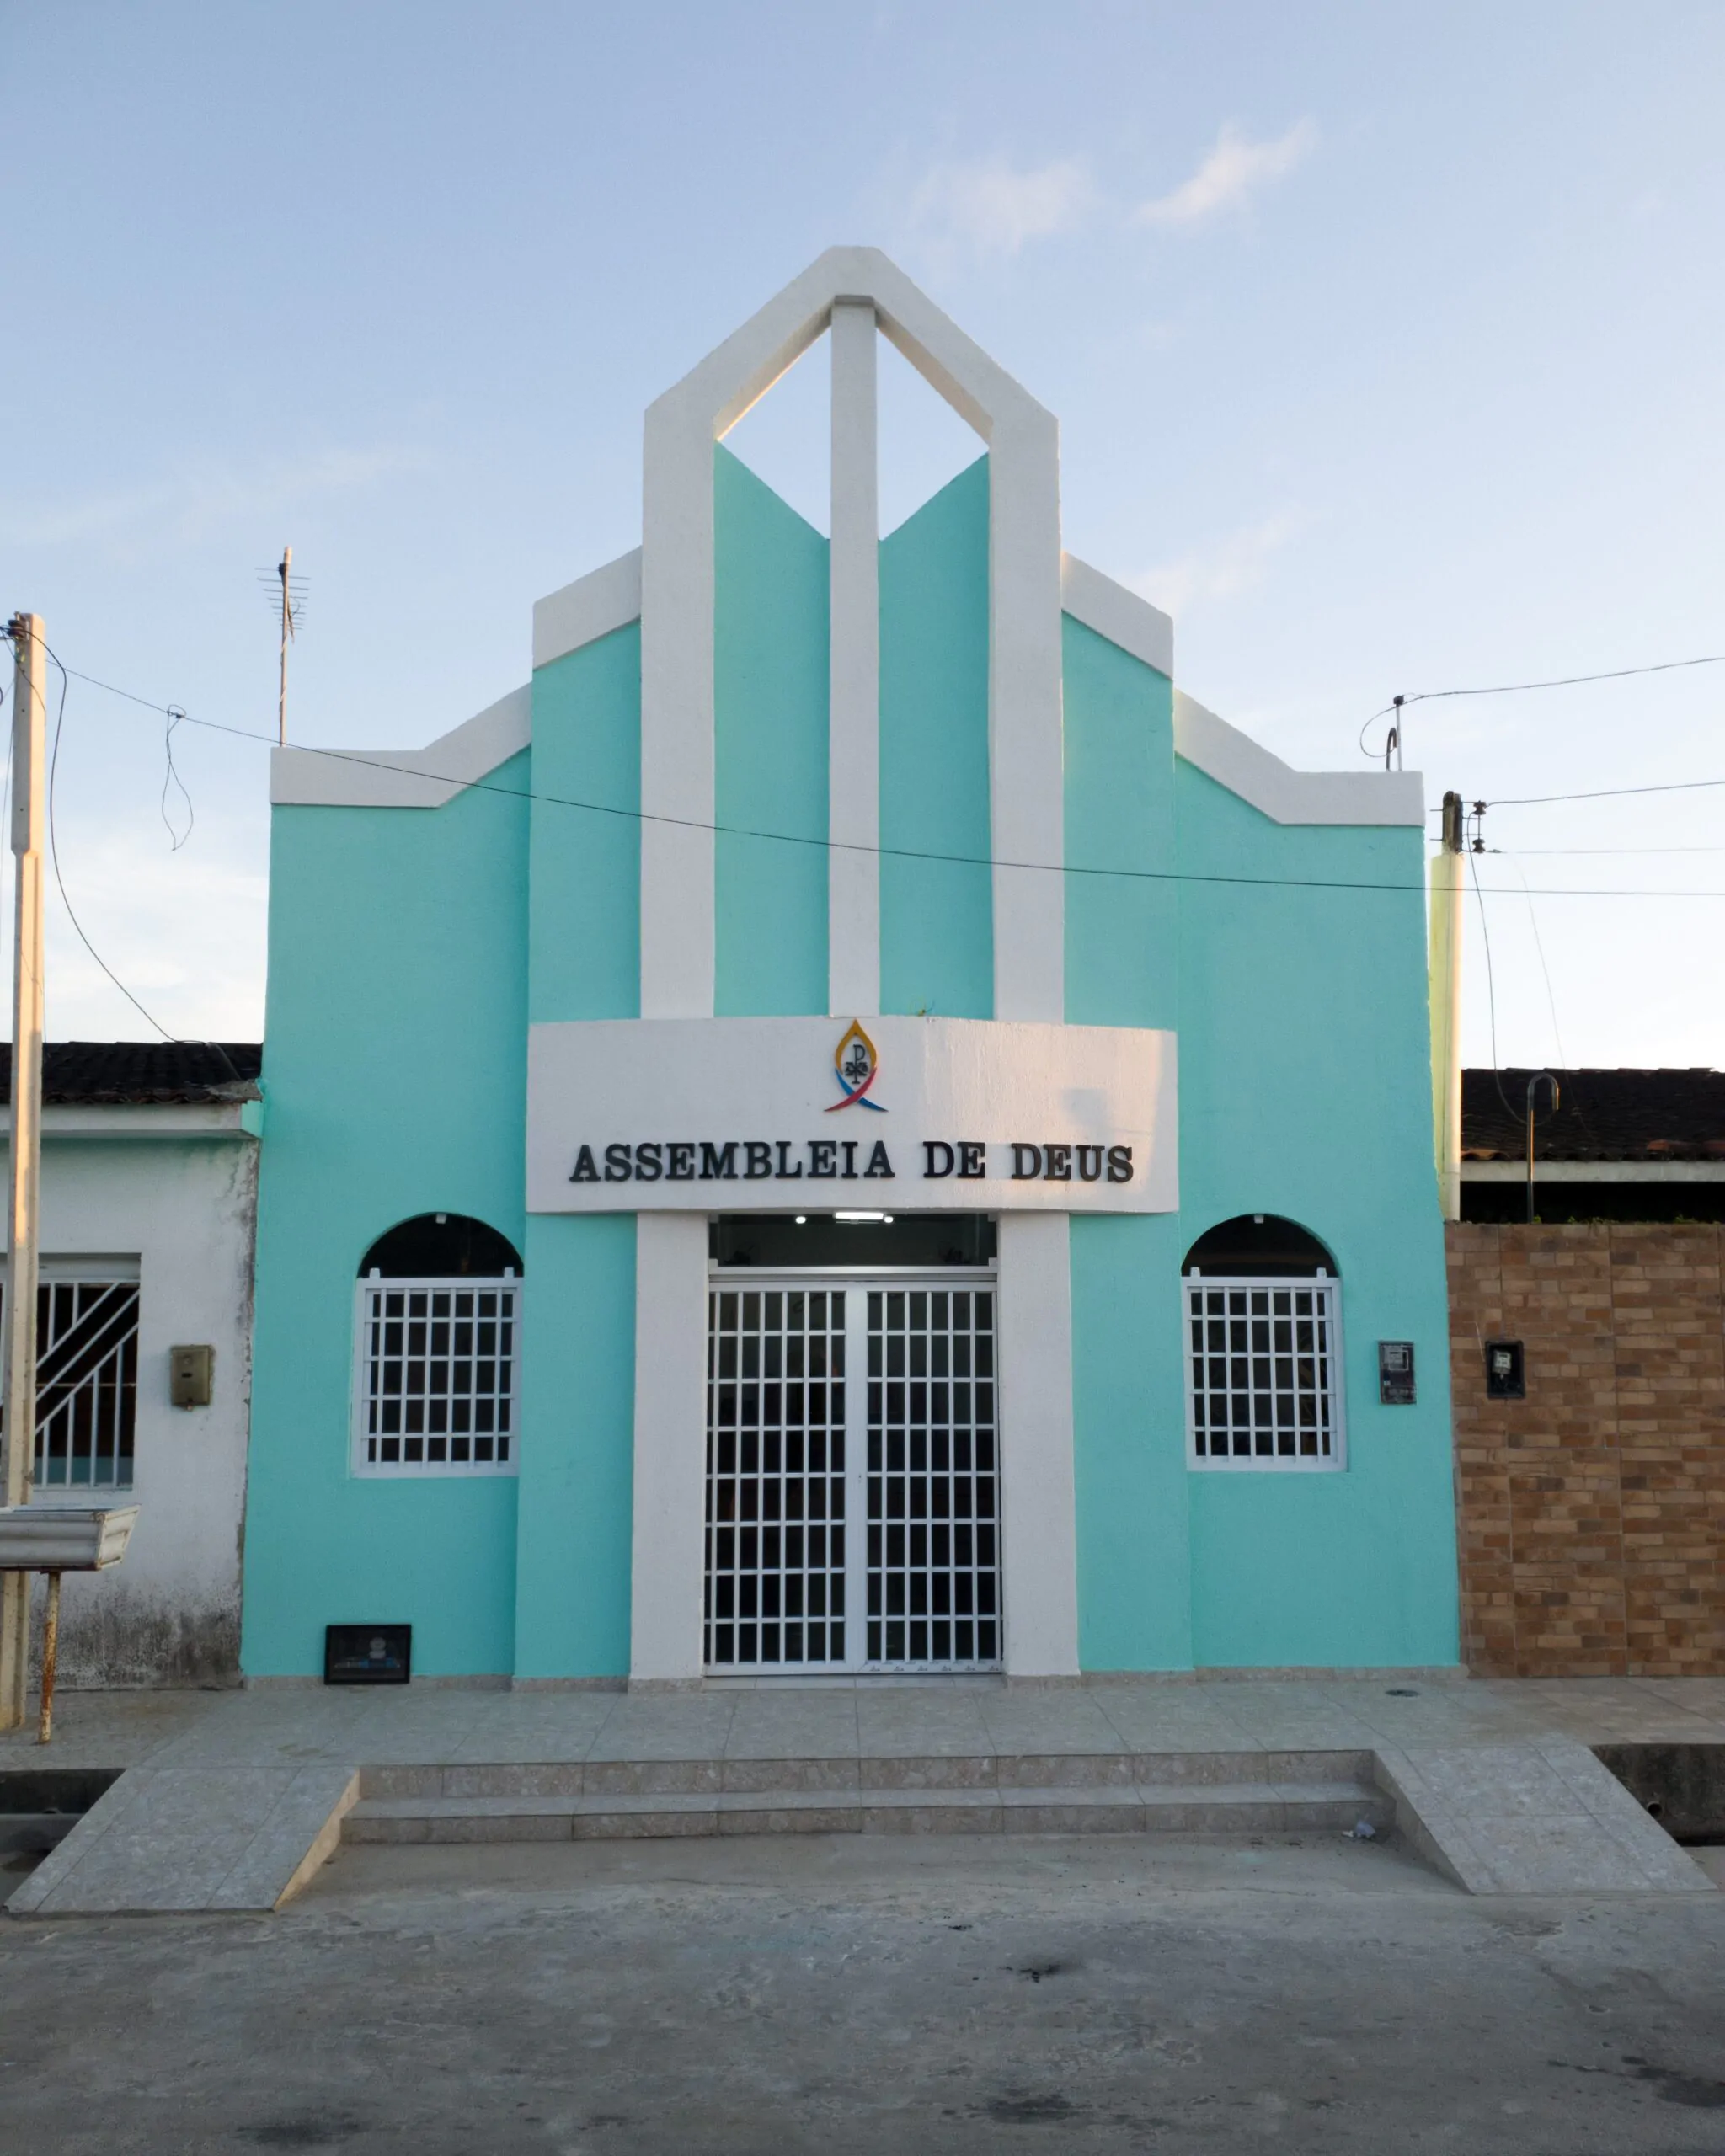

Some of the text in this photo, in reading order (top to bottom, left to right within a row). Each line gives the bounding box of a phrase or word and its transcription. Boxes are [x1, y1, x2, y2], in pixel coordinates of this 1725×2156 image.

[569, 1140, 1134, 1183] ASSEMBLEIA DE DEUS
